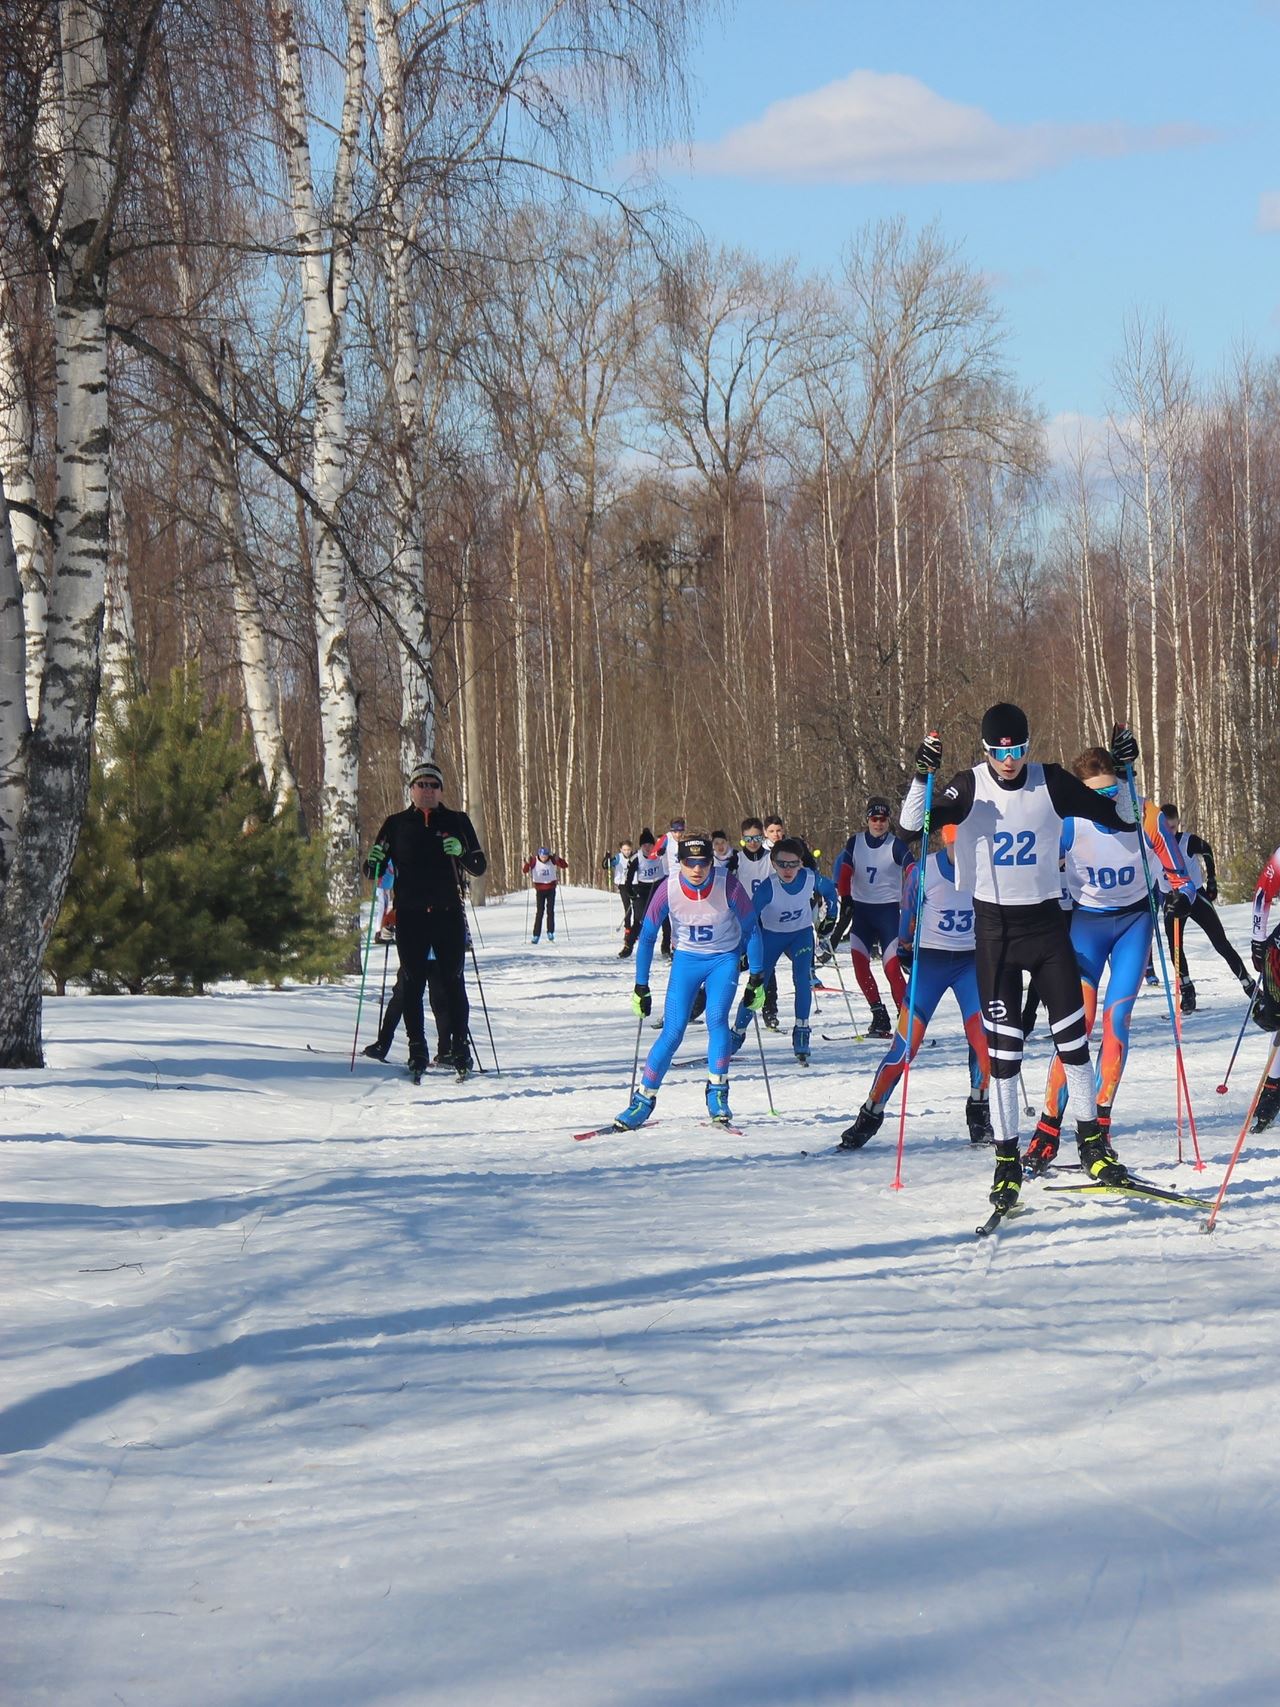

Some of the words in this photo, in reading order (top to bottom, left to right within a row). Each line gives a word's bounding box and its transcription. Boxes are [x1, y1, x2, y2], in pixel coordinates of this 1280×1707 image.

[993, 830, 1037, 866] 22
[866, 866, 878, 884] 7
[1086, 866, 1136, 890] 100
[779, 909, 802, 922] 23
[938, 909, 974, 932] 33
[689, 925, 713, 942] 15
